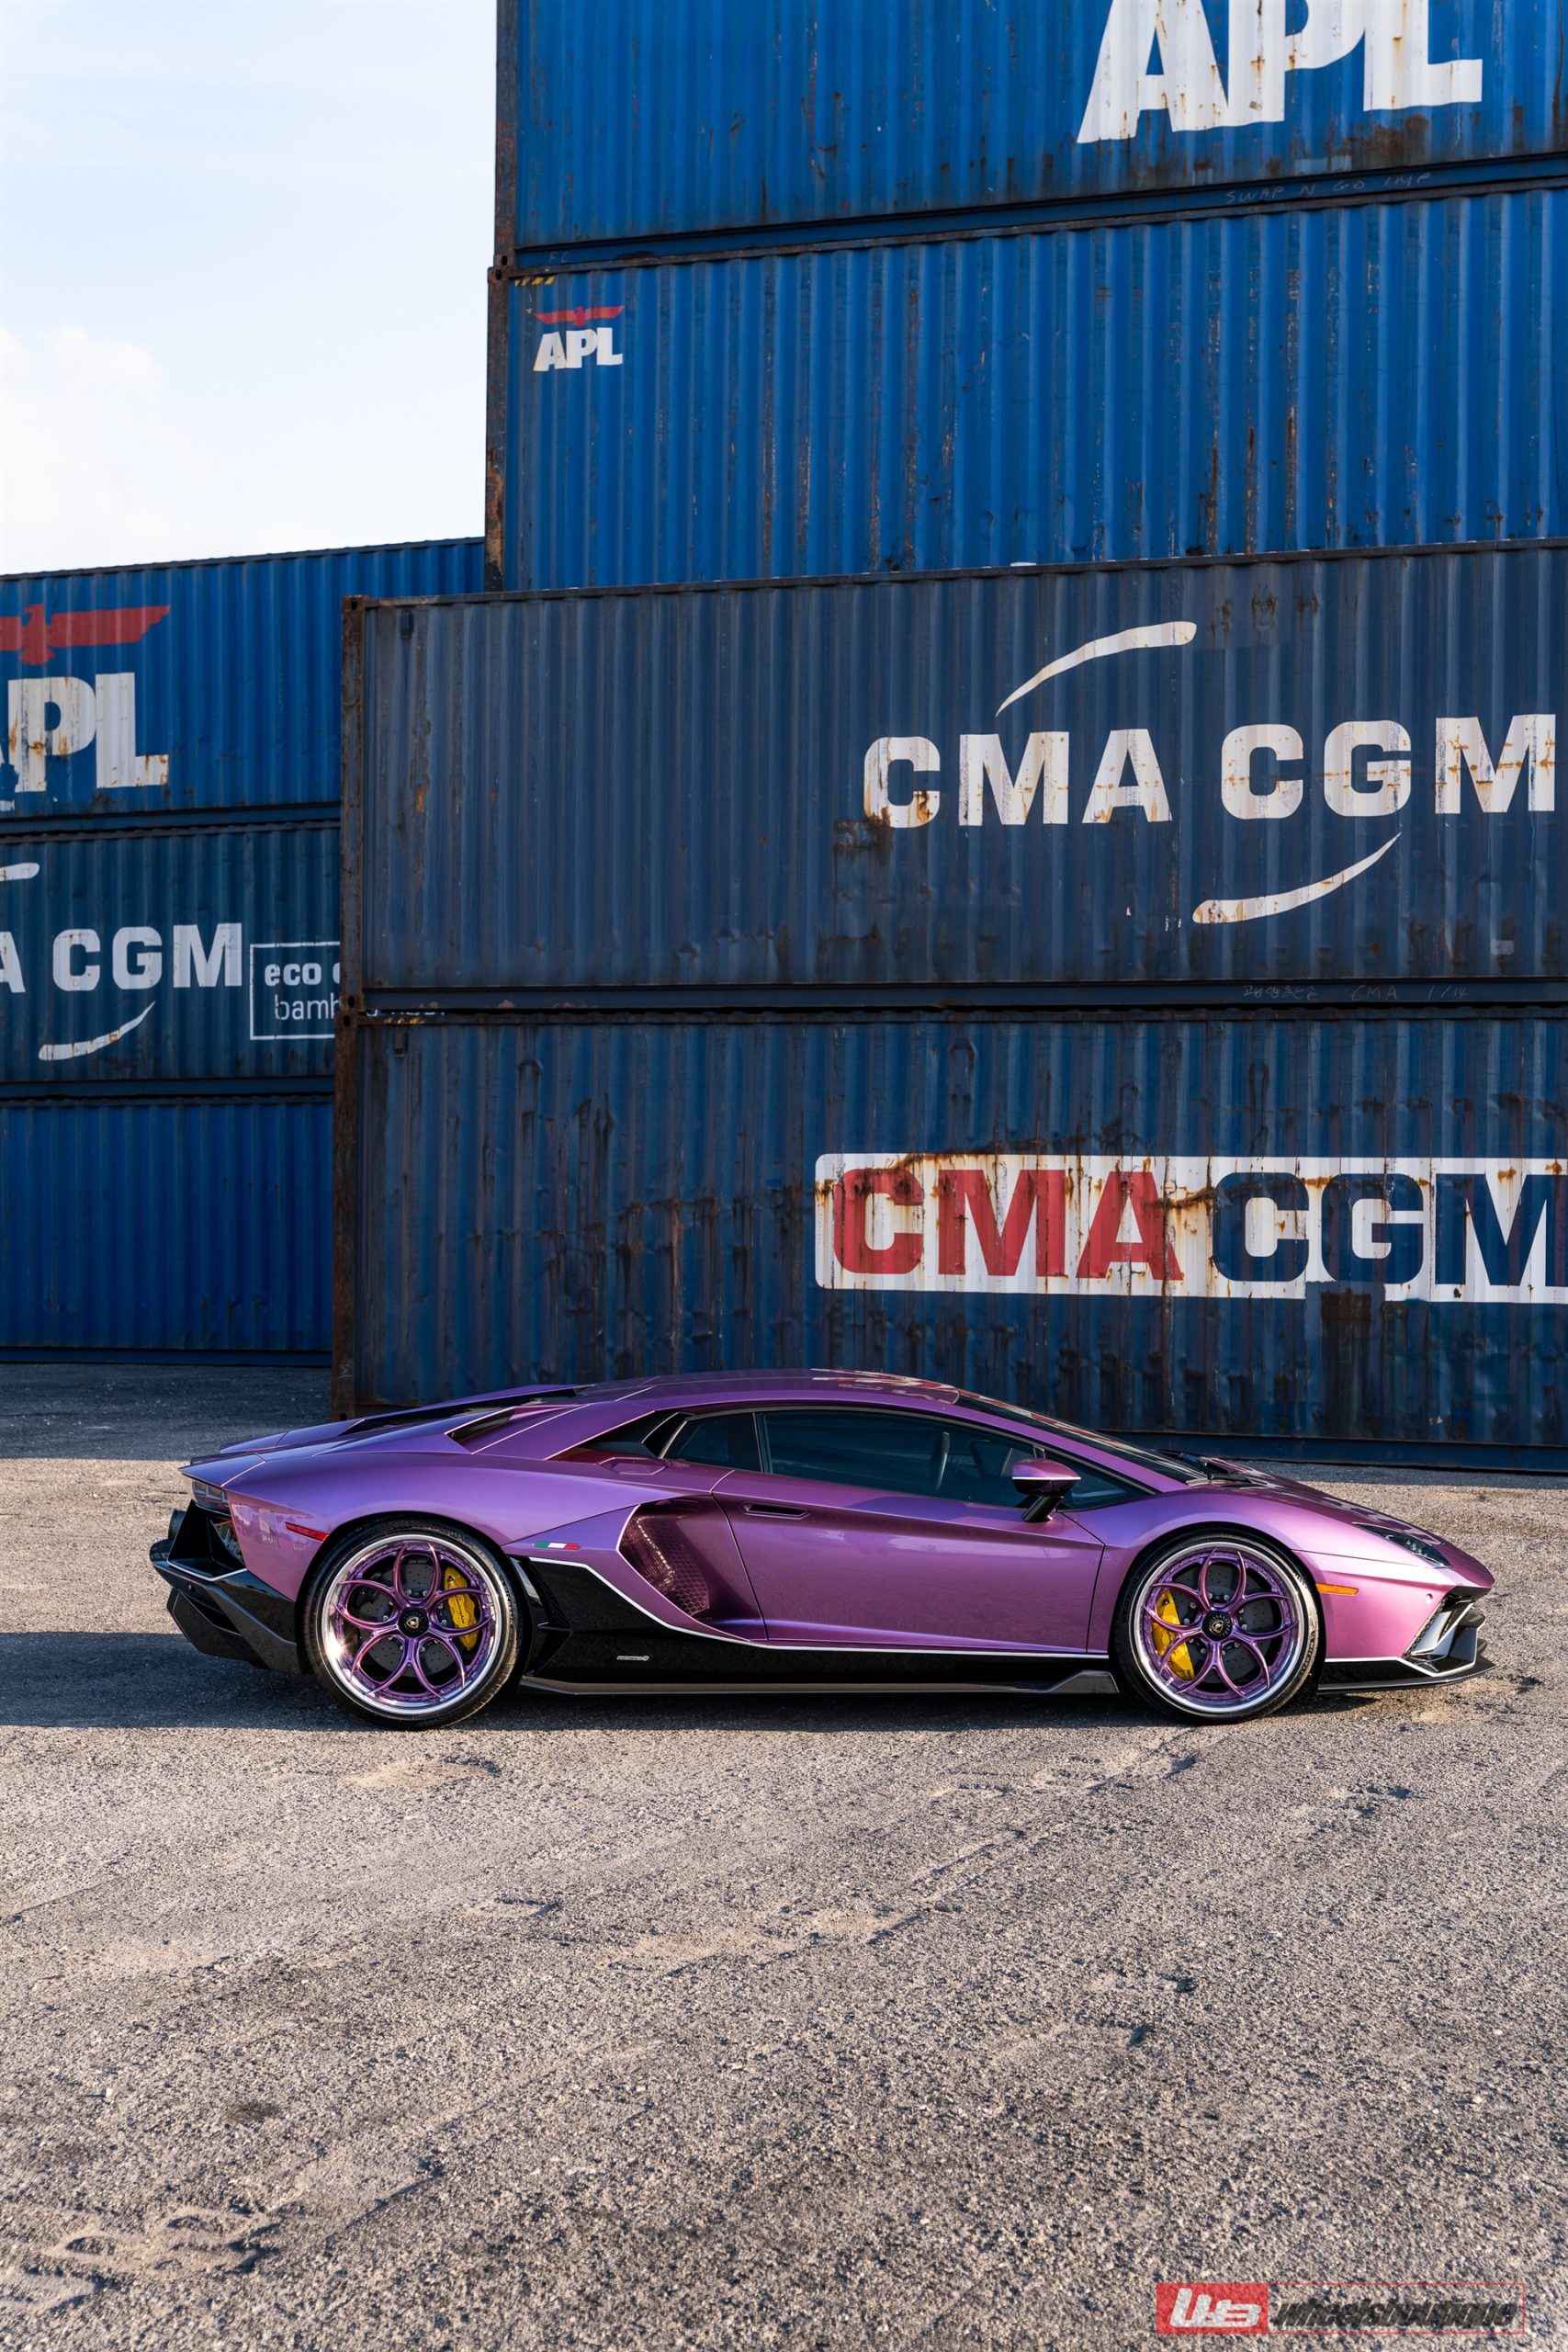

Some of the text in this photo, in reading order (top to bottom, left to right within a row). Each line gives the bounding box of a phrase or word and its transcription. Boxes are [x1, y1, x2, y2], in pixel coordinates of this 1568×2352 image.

[1077, 0, 1482, 143] APL
[1225, 186, 1284, 204] SWAP
[1299, 184, 1315, 196] N
[533, 326, 624, 371] APL
[0, 672, 169, 795] PL
[863, 714, 1555, 828] CMA CGM
[52, 922, 243, 991] CGM
[264, 962, 321, 987] eco
[832, 1168, 1568, 1287] CMA CGM
